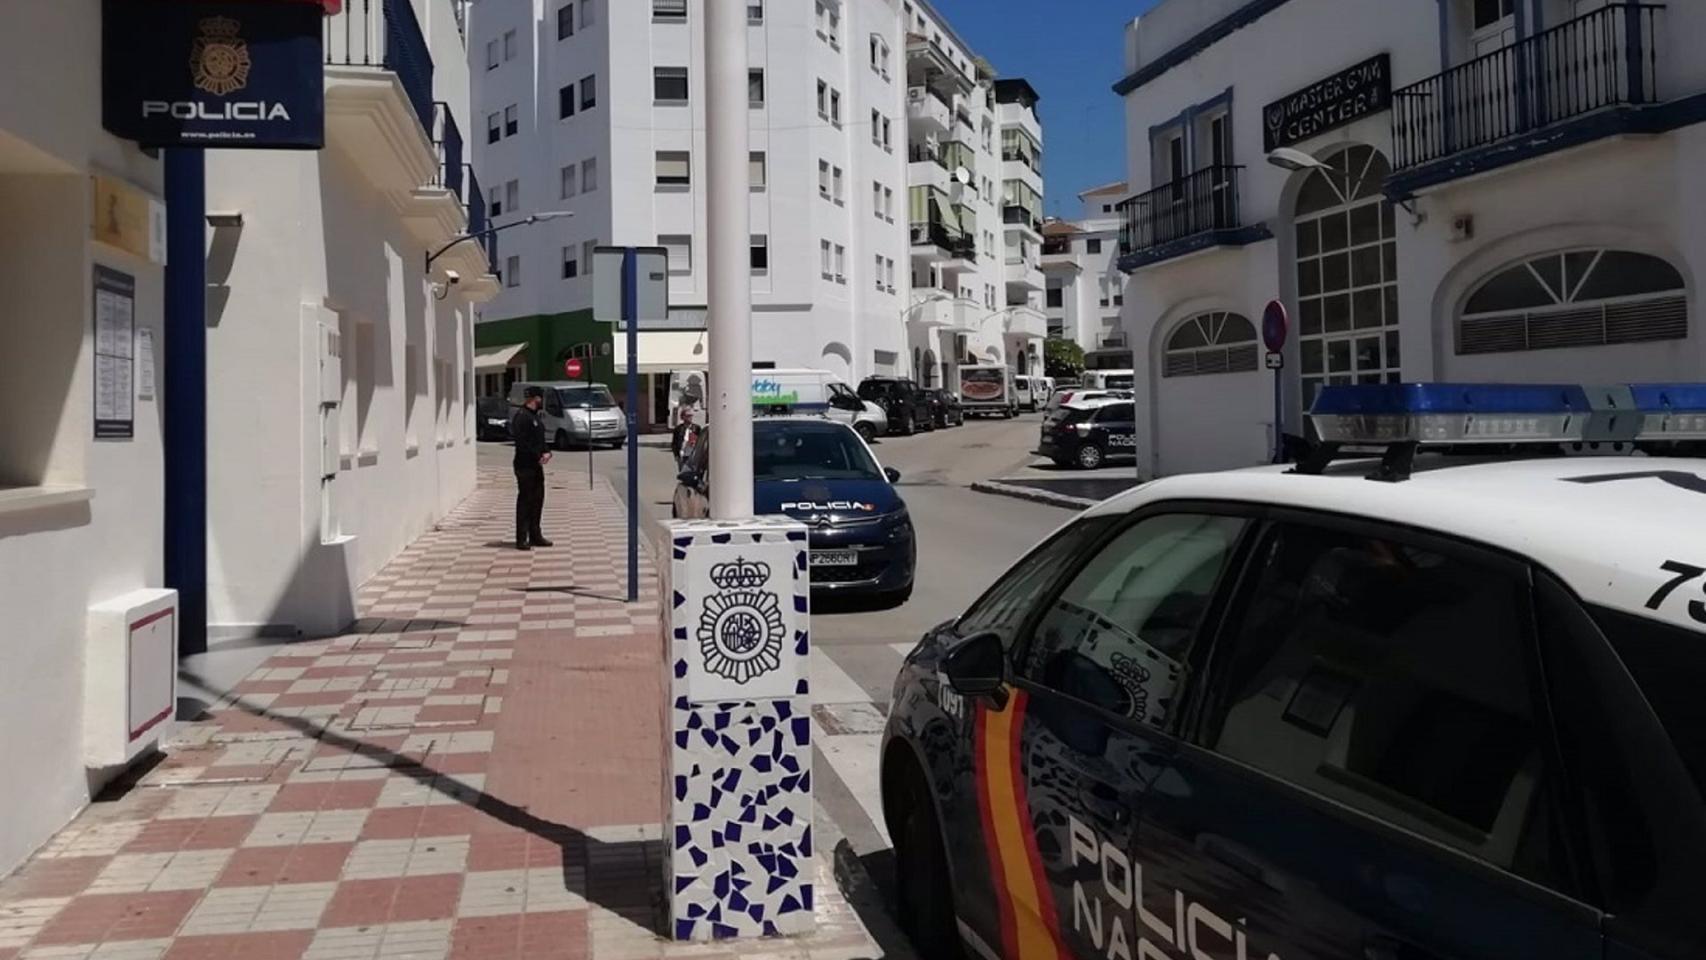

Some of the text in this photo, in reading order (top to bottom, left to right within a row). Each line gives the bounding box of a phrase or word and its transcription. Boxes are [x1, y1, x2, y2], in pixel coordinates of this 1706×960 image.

[1286, 77, 1342, 117] MASTER
[1346, 61, 1381, 90] GYM
[1288, 93, 1367, 139] CENTER
